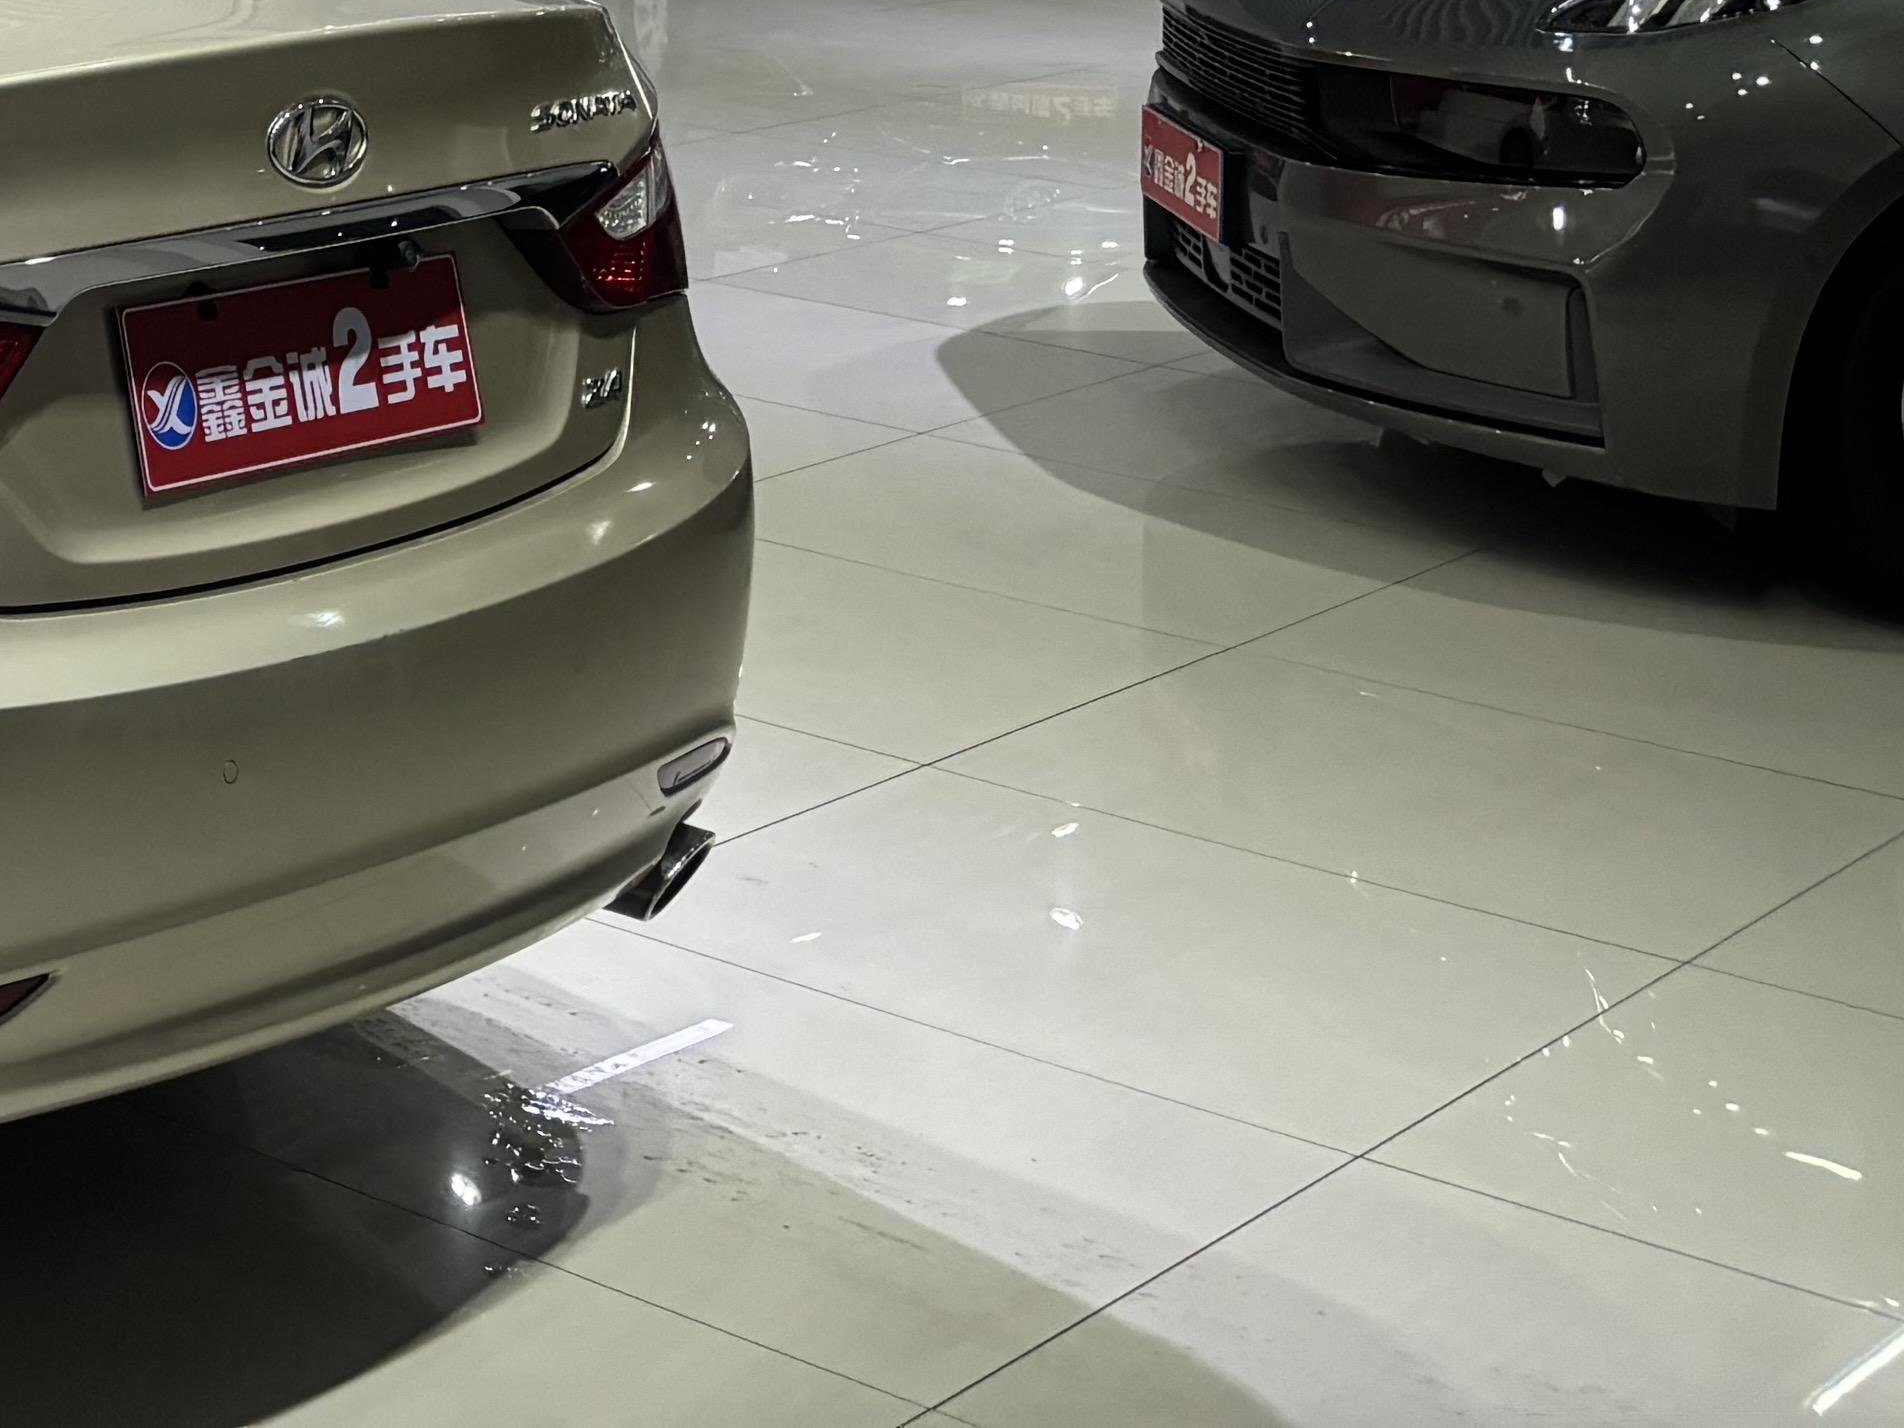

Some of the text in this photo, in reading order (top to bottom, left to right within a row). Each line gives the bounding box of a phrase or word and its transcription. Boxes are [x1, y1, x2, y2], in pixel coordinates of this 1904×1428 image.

[194, 305, 469, 444] 鑫金诚2手车
